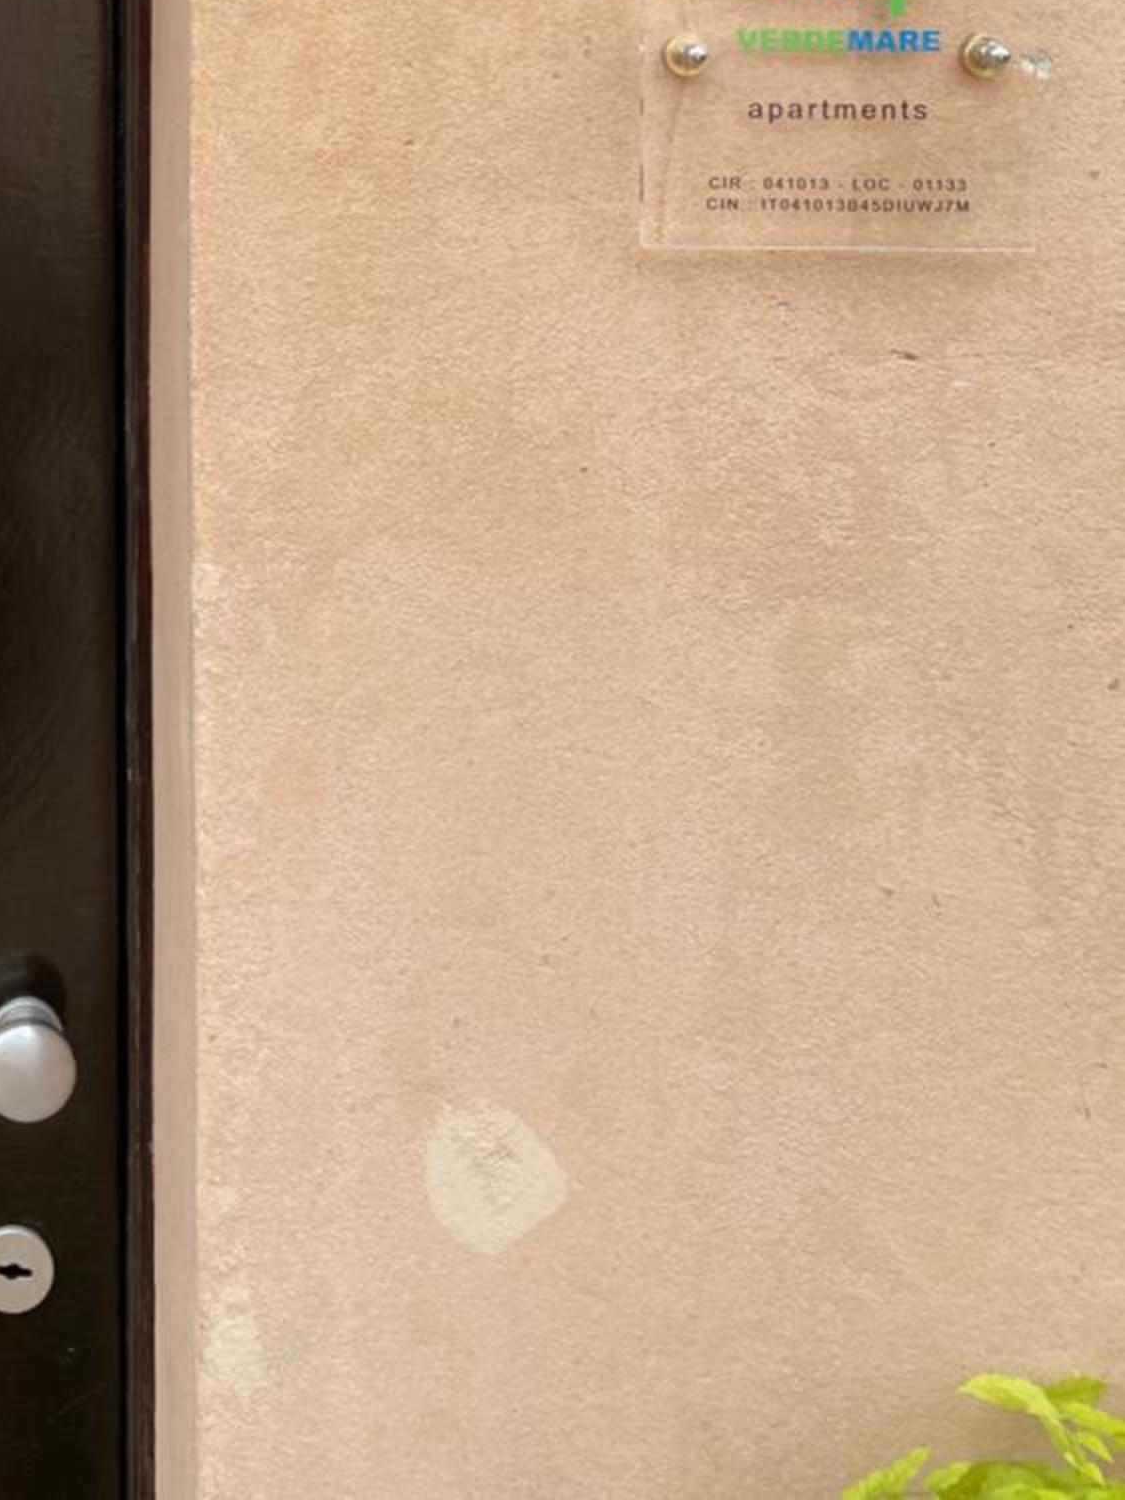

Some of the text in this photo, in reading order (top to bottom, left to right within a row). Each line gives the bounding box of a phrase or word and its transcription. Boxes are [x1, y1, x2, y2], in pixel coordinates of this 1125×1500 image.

[747, 100, 928, 123] apartments
[708, 176, 742, 190] CIR
[763, 176, 829, 191] 041013
[851, 177, 891, 191] LOC
[706, 197, 740, 211] CIN
